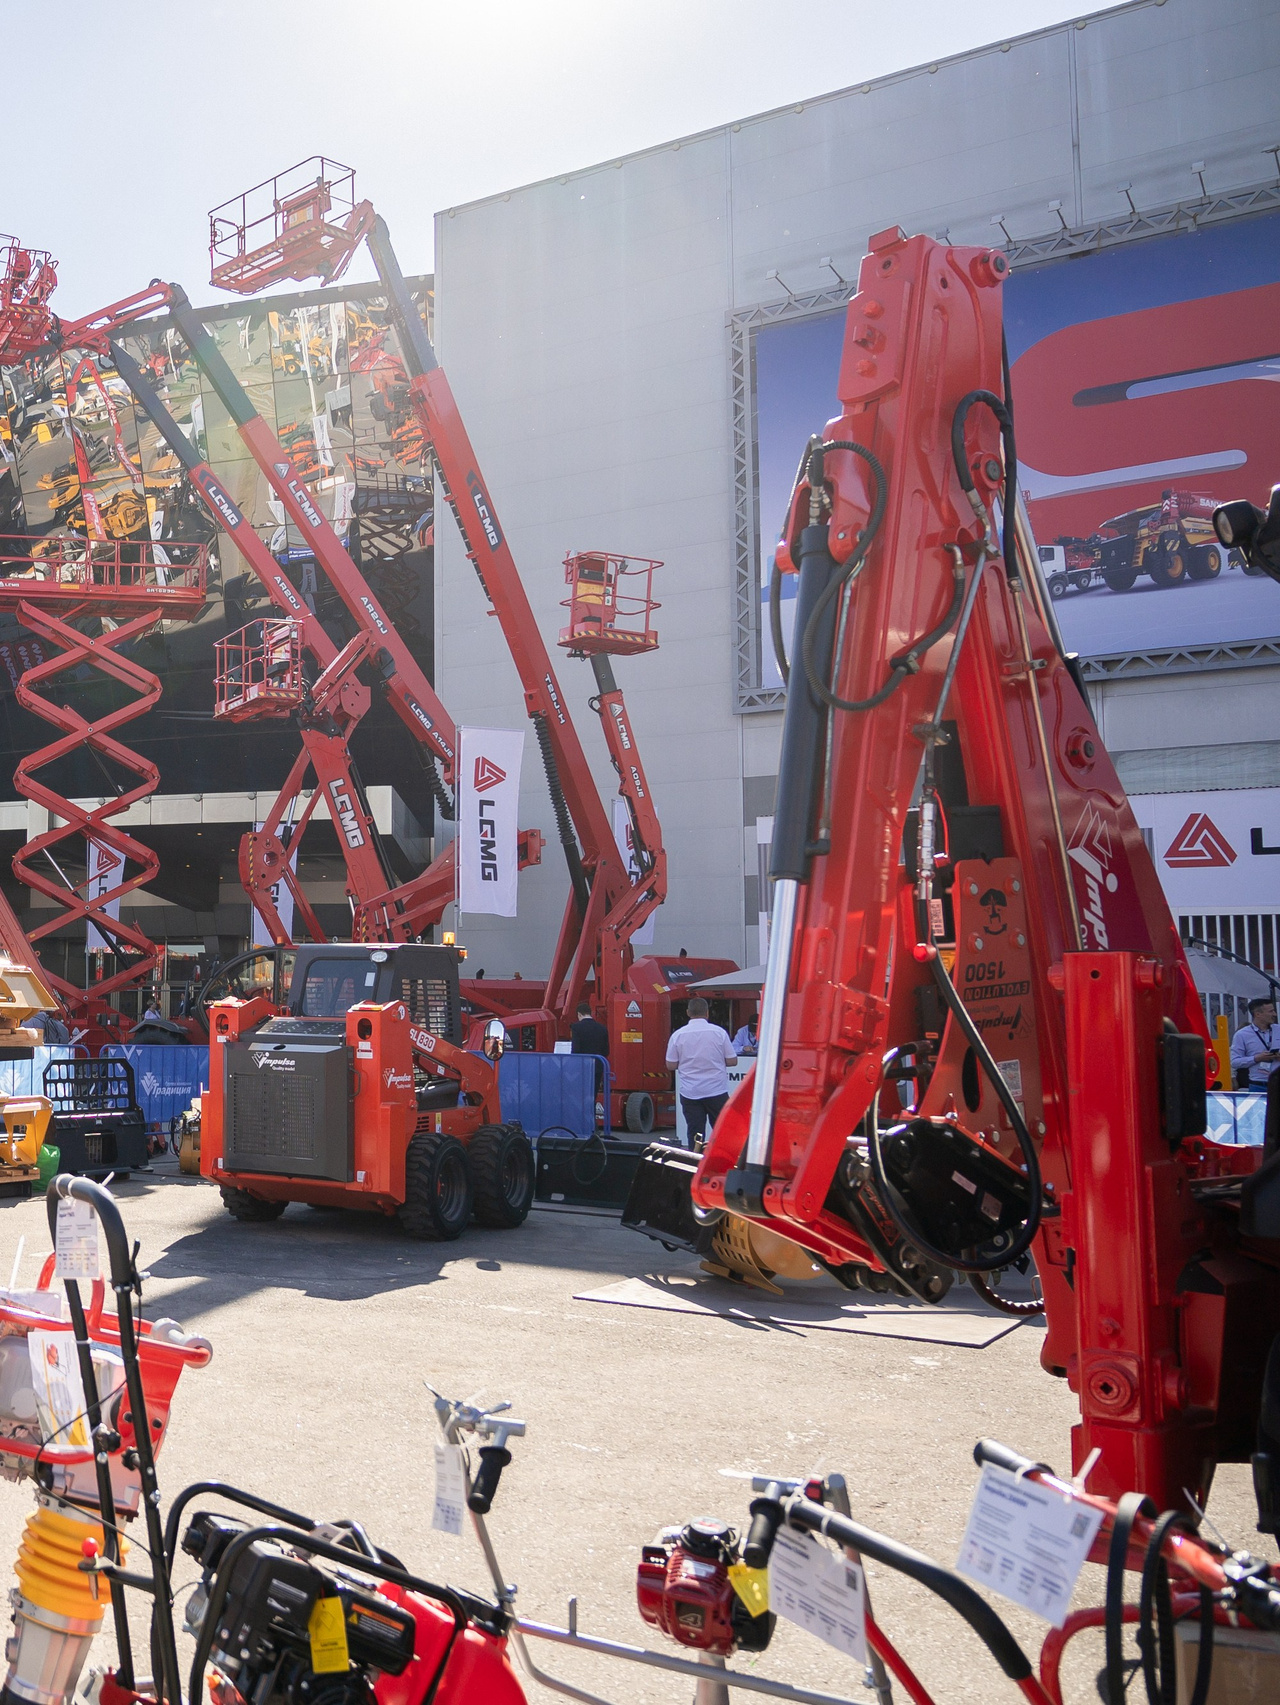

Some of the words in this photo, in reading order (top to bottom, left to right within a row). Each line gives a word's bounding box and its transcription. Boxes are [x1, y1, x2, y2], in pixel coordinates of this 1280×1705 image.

[273, 575, 301, 610] AR20J
[360, 596, 388, 635] AR24J
[965, 961, 1006, 983] 1500
[965, 981, 1029, 1000] EVOLUTION
[409, 1028, 417, 1042] SL
[418, 1032, 433, 1049] 830
[152, 1083, 192, 1098] Традиция
